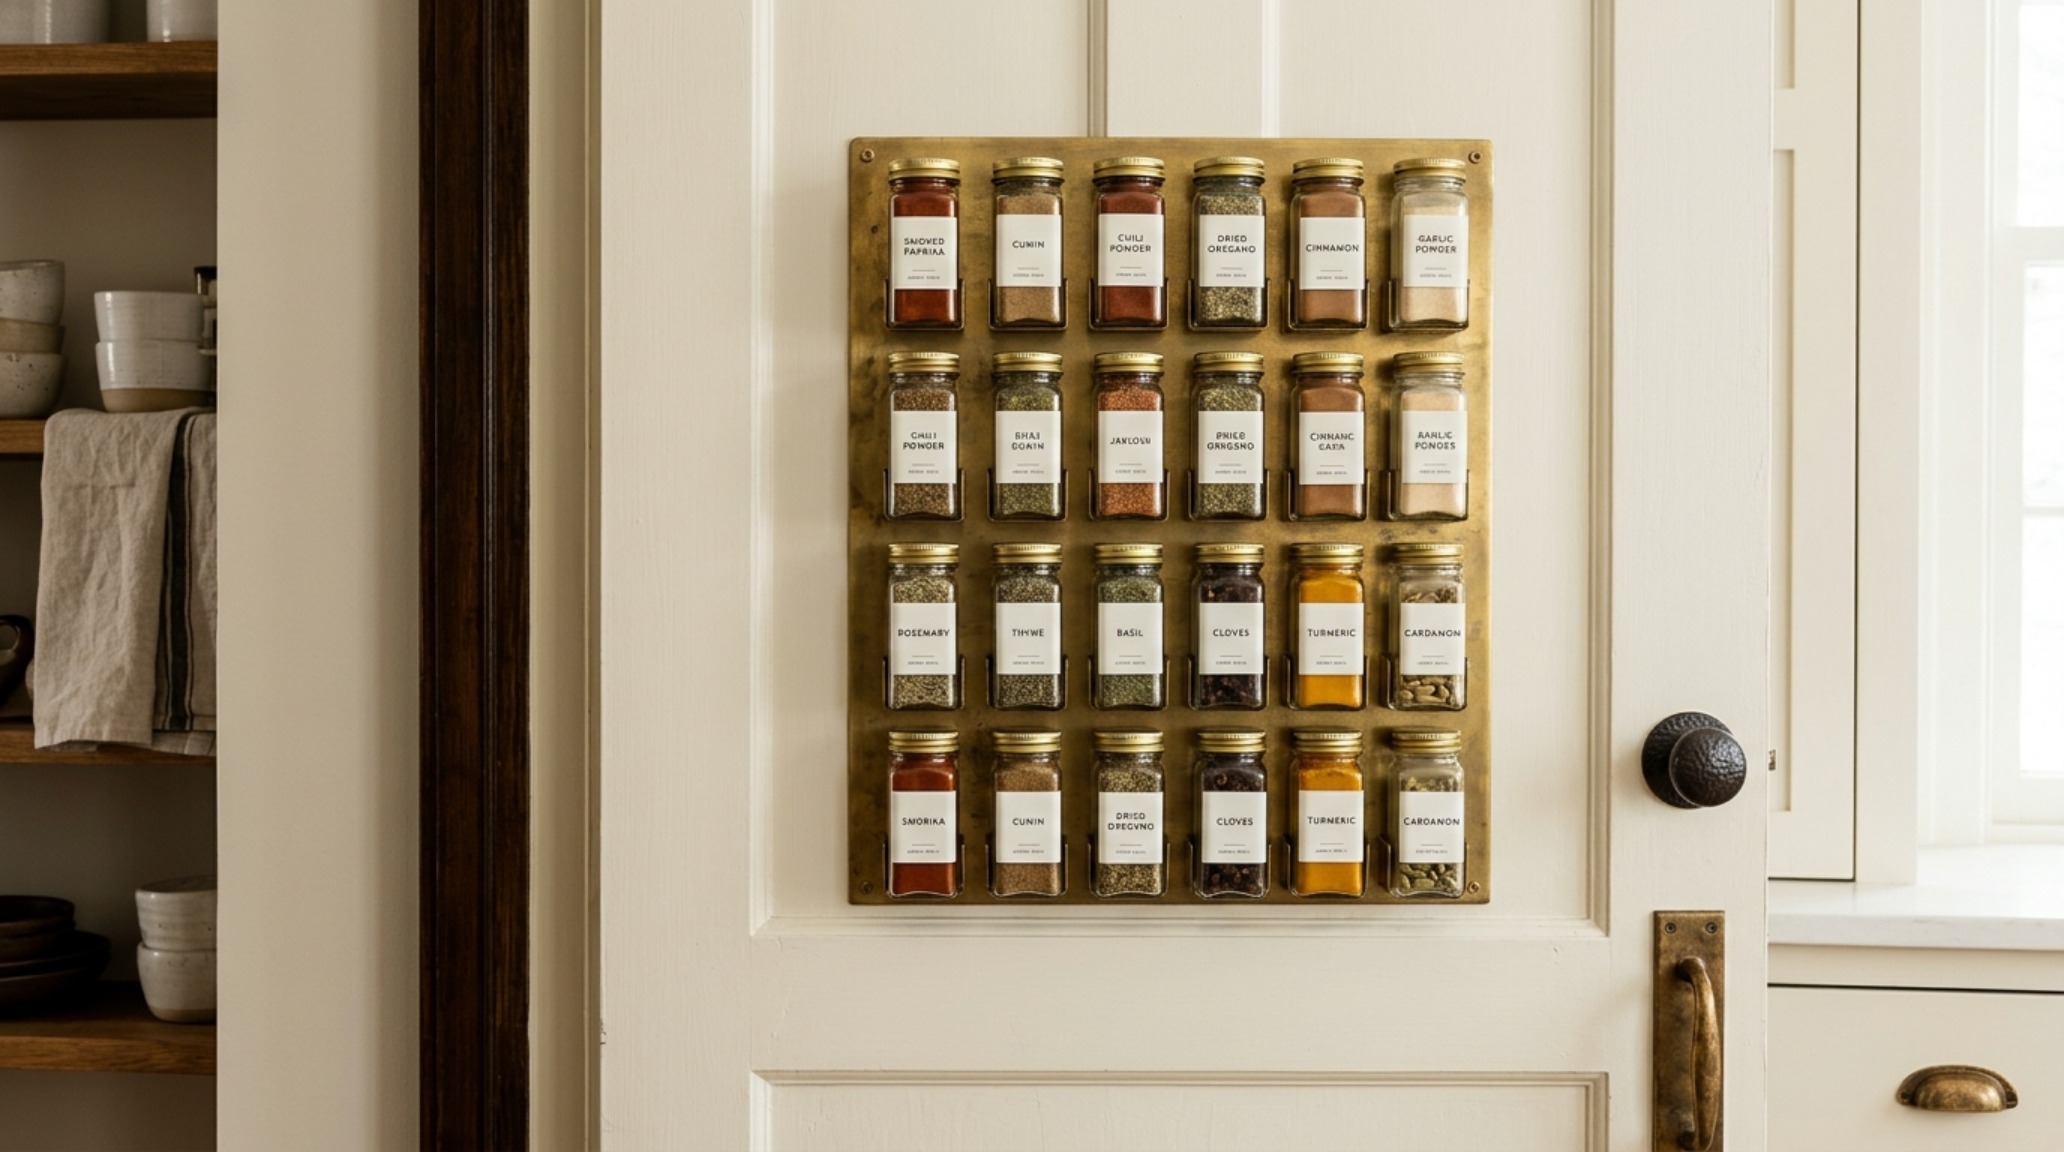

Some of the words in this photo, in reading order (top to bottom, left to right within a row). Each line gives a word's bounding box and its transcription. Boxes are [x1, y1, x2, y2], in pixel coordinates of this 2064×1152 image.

[1217, 234, 1248, 243] DRIED
[1116, 628, 1144, 637] BASIL
[1212, 628, 1250, 637] CLOVES
[1215, 817, 1254, 826] CLOVES
